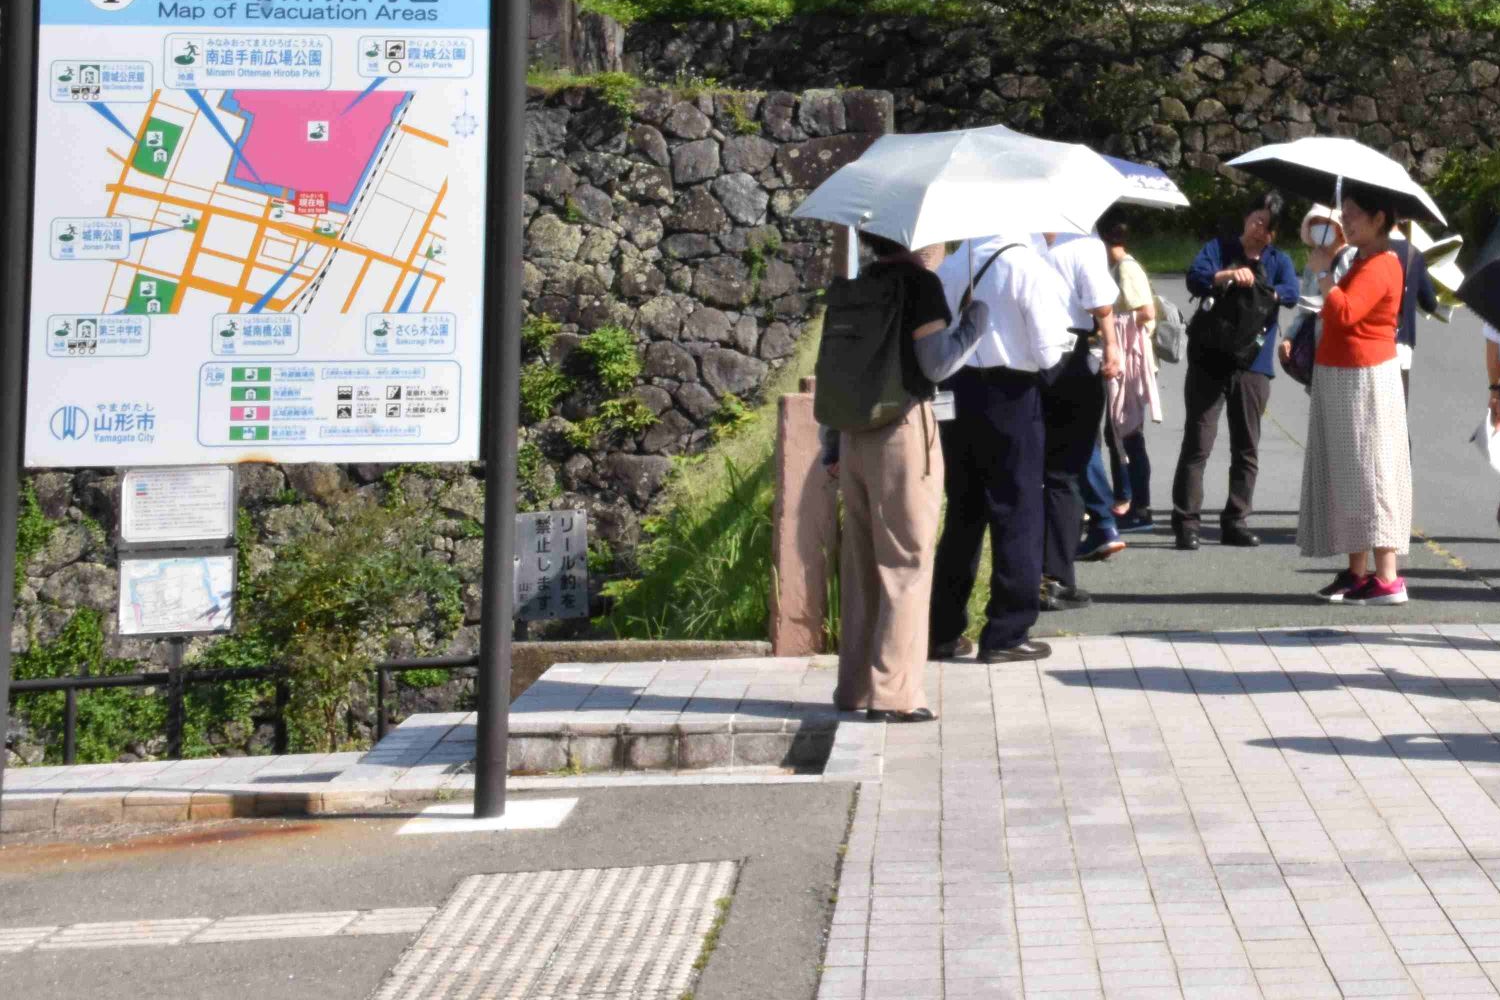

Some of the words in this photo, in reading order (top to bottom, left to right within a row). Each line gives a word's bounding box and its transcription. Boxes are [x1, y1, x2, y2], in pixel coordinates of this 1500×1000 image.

[158, 2, 206, 20] Map
[213, 2, 237, 19] of
[246, 3, 367, 21] Evacuation
[376, 4, 439, 22] Areas
[206, 49, 322, 66] 南追手前広場公園
[206, 67, 236, 78] Minami
[273, 69, 300, 78] Hiroba
[302, 69, 321, 78] Park
[408, 62, 430, 70] Kajo
[396, 324, 449, 337] さくら木公園
[97, 402, 155, 412] やまがたし
[94, 413, 156, 432] 山形市
[94, 433, 136, 444] Yamagata
[137, 433, 155, 444] City
[536, 518, 552, 611] 禁止します
